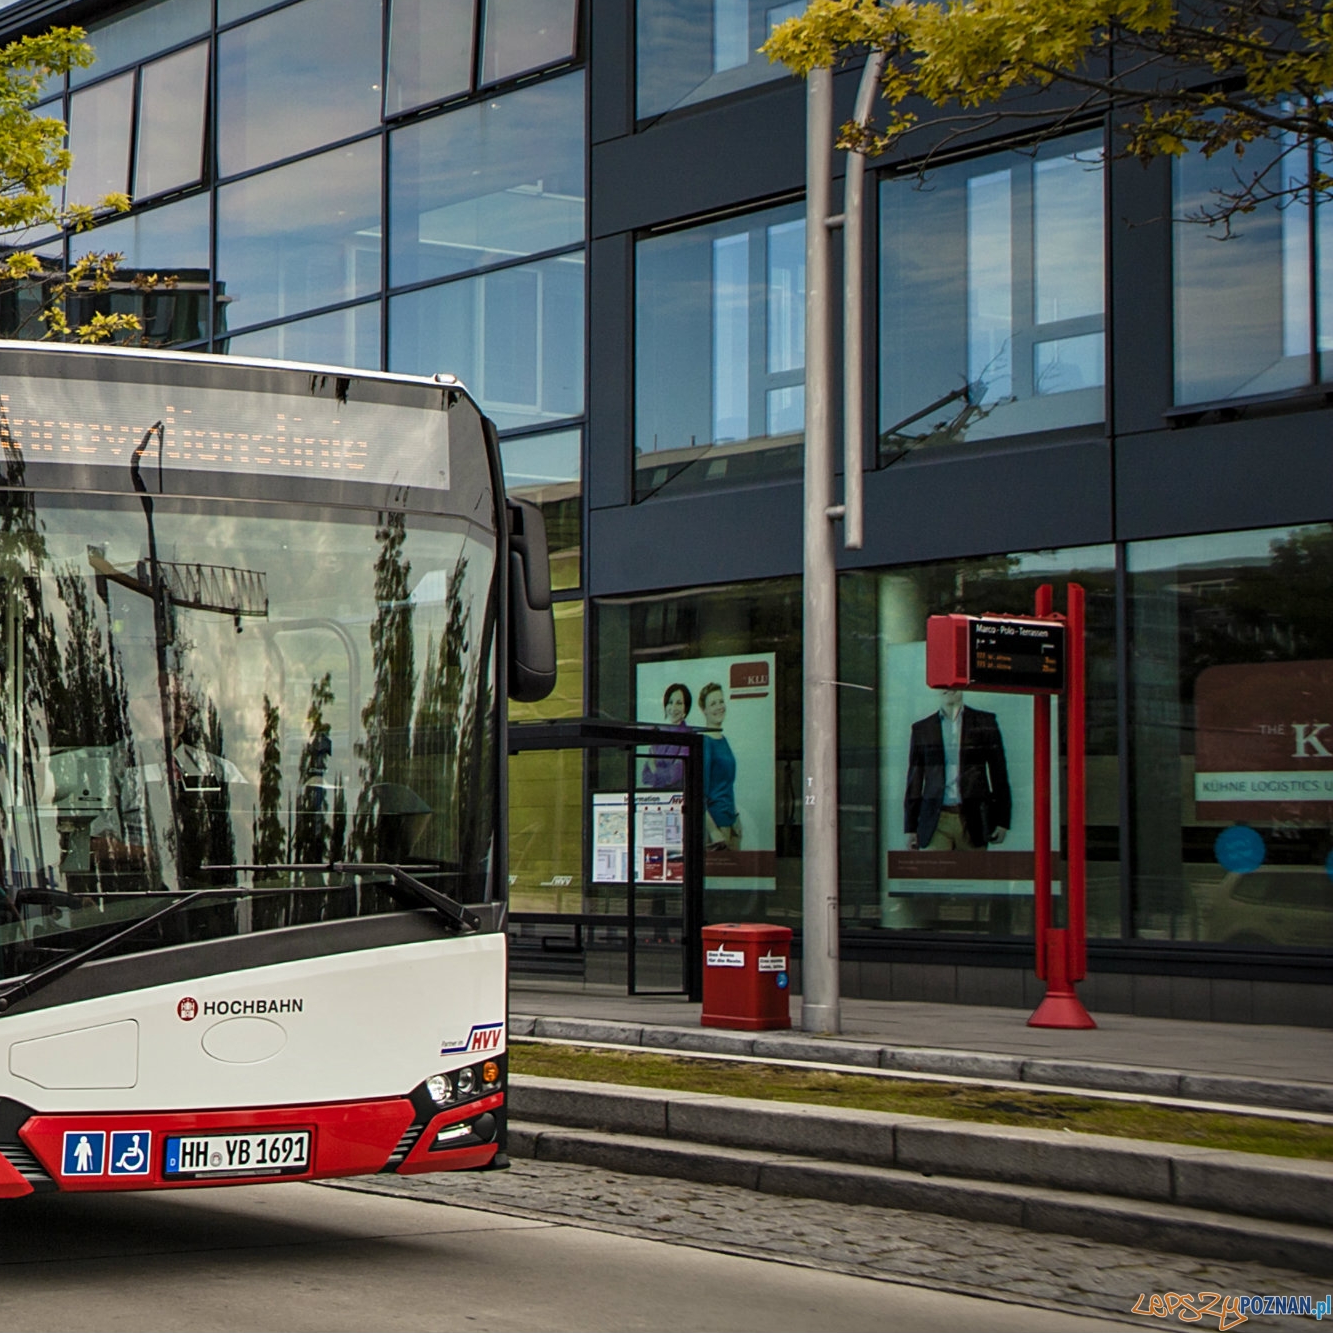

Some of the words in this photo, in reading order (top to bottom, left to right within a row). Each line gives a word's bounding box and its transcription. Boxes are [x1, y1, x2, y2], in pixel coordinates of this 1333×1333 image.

[976, 624, 996, 633] Marco
[1000, 626, 1014, 635] Polo
[1019, 627, 1049, 637] Terrassen
[1260, 724, 1285, 735] THE
[807, 777, 813, 787] T
[1251, 780, 1319, 792] LOGISTICS
[805, 795, 815, 805] 22
[204, 999, 303, 1016] HOCHBAHN
[472, 1029, 502, 1050] HVV
[170, 1158, 176, 1166] D
[181, 1141, 208, 1168] HH
[226, 1139, 251, 1165] YB
[256, 1136, 305, 1164] 1691
